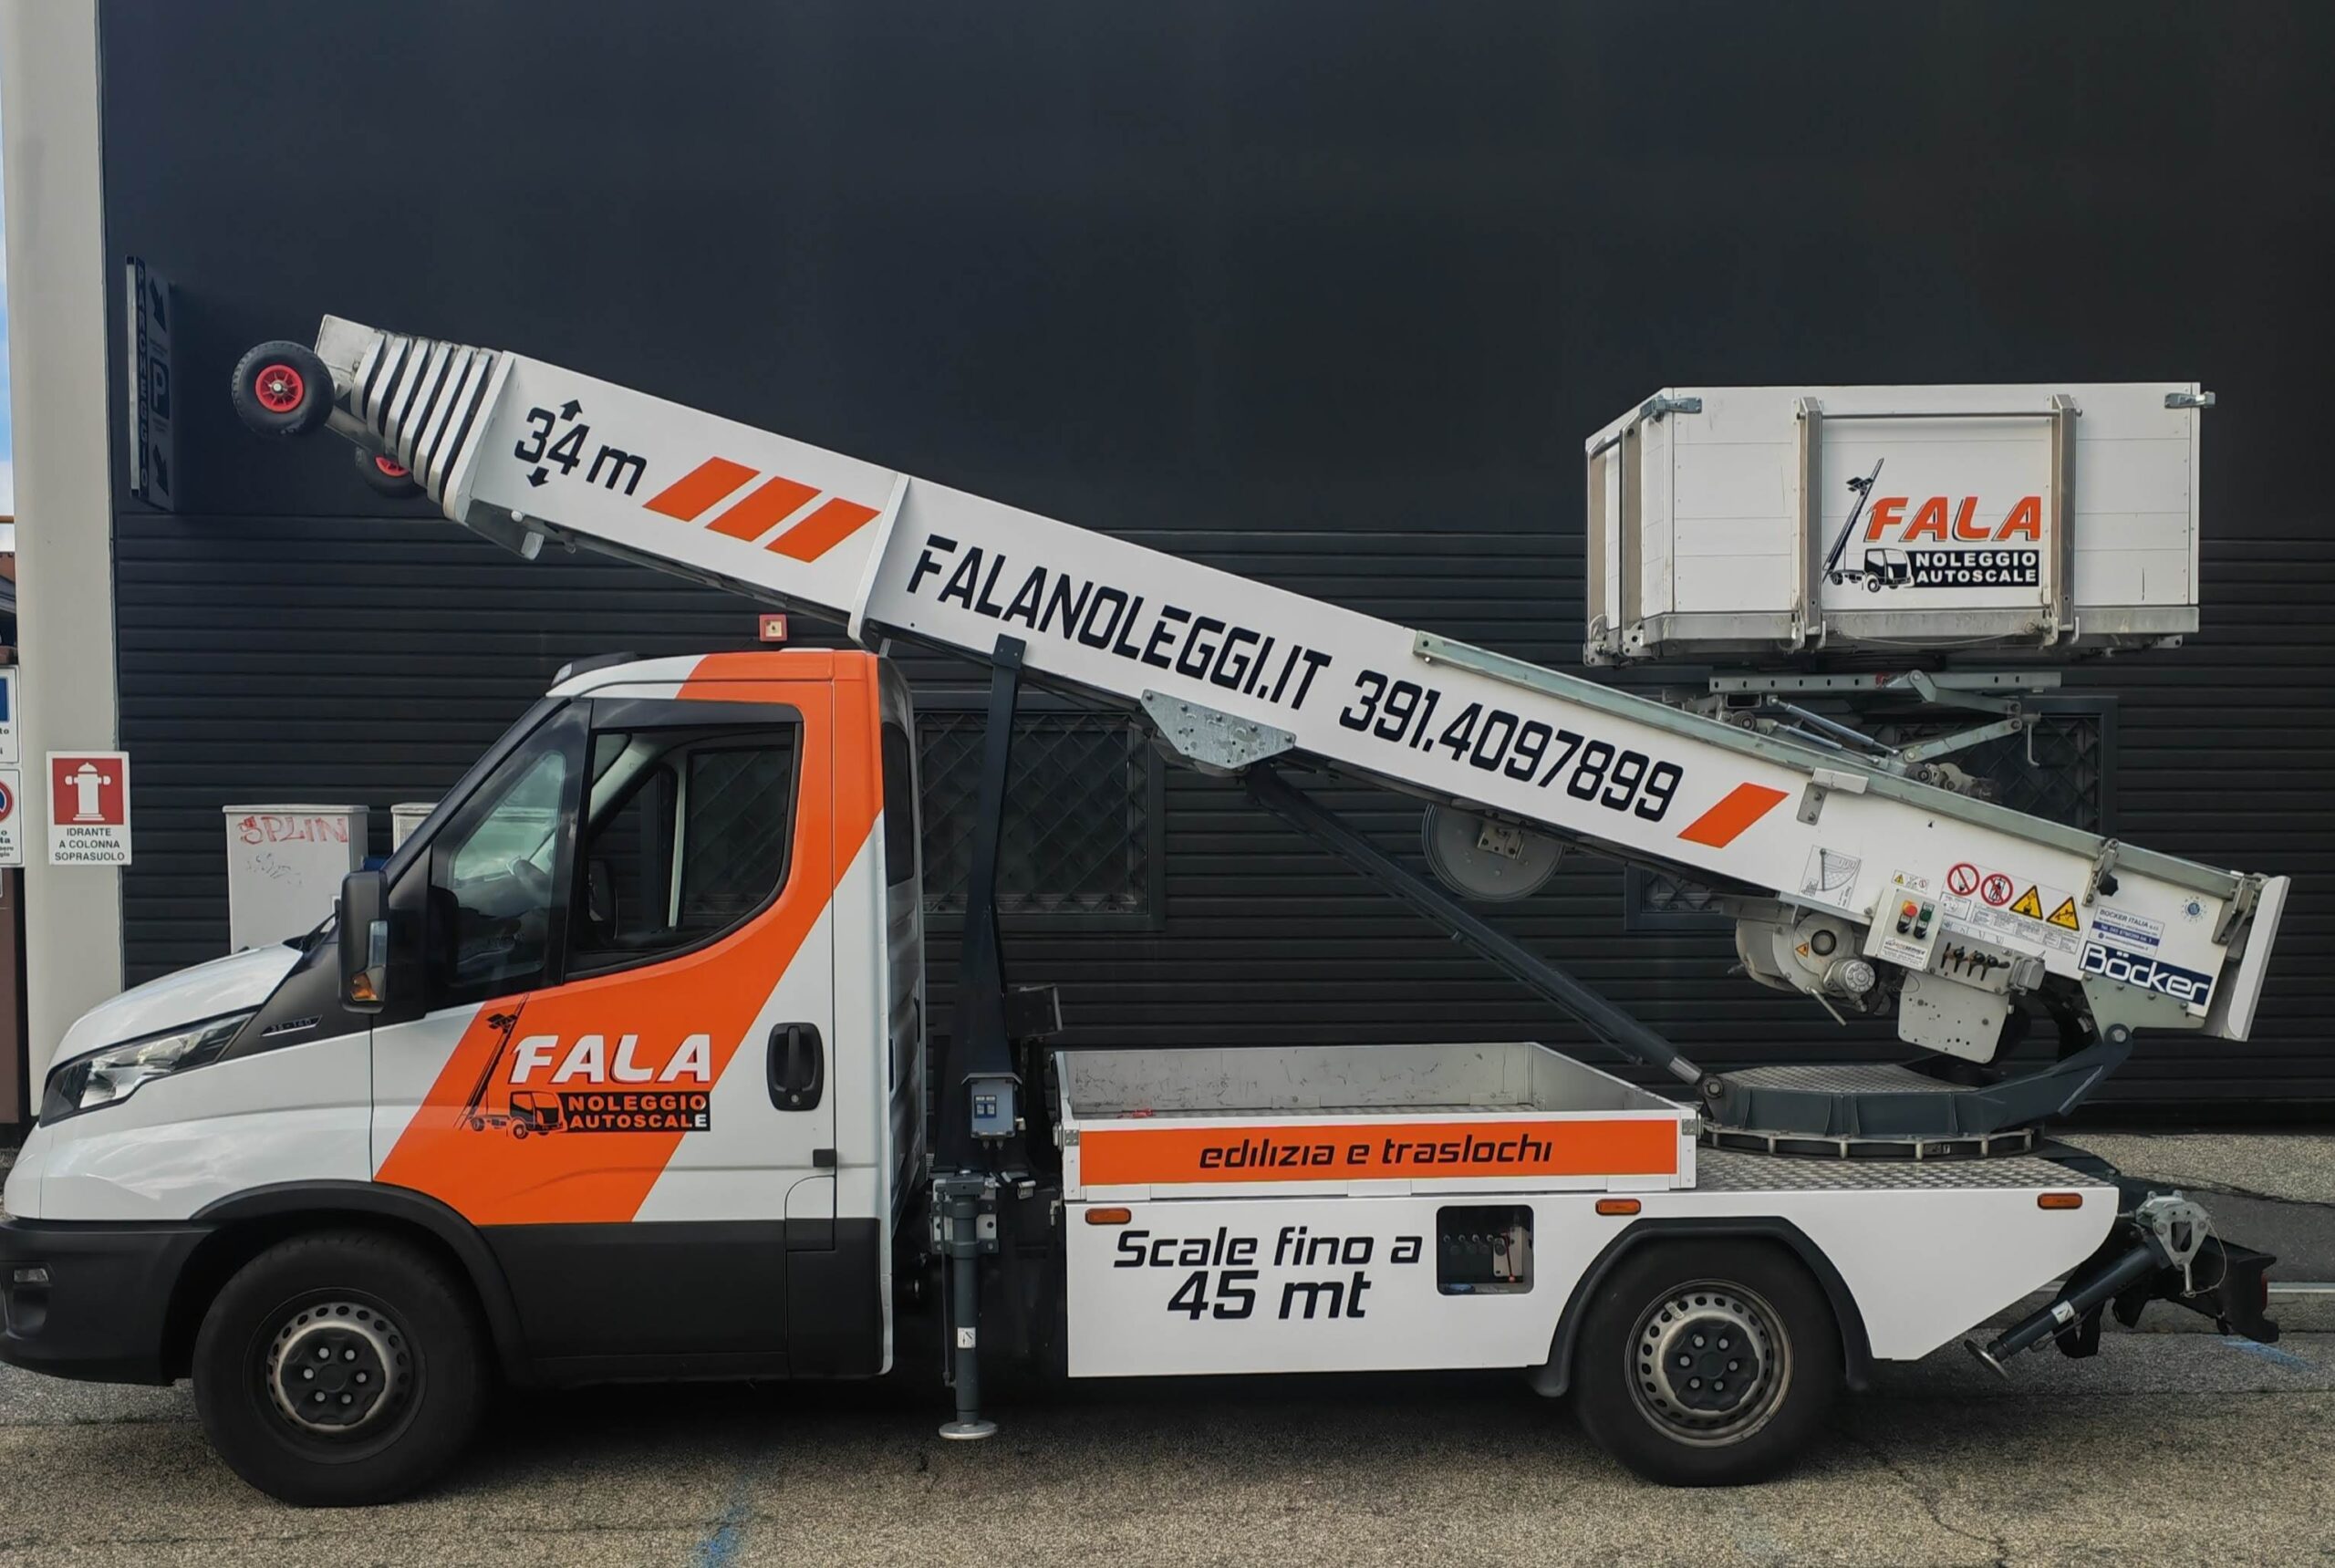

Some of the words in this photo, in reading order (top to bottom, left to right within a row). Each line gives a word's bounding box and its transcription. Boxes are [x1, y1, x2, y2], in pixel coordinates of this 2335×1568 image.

[514, 408, 589, 475] 34
[586, 445, 647, 495] m
[1863, 496, 2041, 543] FALA
[1916, 552, 2037, 567] NOLEGGIO
[1916, 569, 2037, 583] AUTOSCALE
[907, 535, 1332, 710] FALANOLEGGI.IT
[1340, 670, 1683, 822] 391.4097899
[58, 839, 67, 848] A
[68, 839, 120, 848] COLONNA
[66, 827, 111, 836] IDRANTE
[54, 852, 125, 861] SOPRASUOLO
[2128, 917, 2148, 928] ITALIA
[2080, 942, 2209, 1001] Böcker
[509, 1033, 711, 1084] FALA
[568, 1095, 706, 1112] NOLEGGIO
[569, 1114, 707, 1128] AUTOSCALE
[1200, 1139, 1334, 1168] edilizia
[1347, 1145, 1369, 1165] e
[1382, 1134, 1552, 1164] traslochi
[1114, 1227, 1257, 1267] Scale
[1274, 1227, 1374, 1265] fino
[1391, 1237, 1422, 1264] a
[1168, 1270, 1259, 1320] 45
[1279, 1272, 1371, 1319] mt
